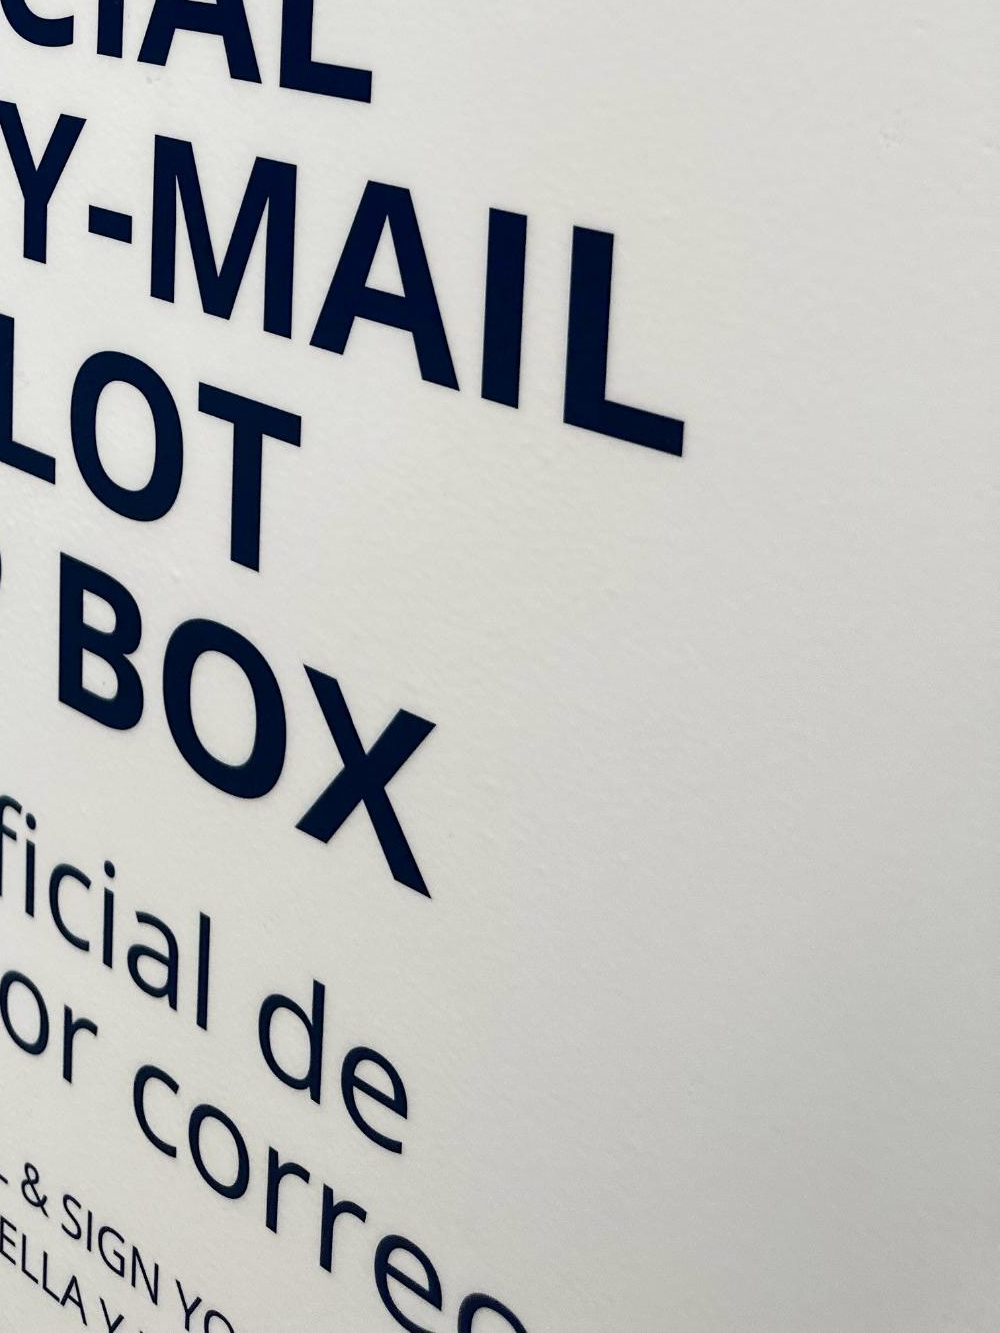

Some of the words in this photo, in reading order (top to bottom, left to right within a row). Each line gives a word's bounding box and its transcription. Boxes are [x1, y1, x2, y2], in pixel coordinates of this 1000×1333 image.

[58, 550, 437, 899] BOX
[258, 978, 408, 1154] de
[21, 1162, 49, 1218] &
[61, 1194, 159, 1306] SIGN
